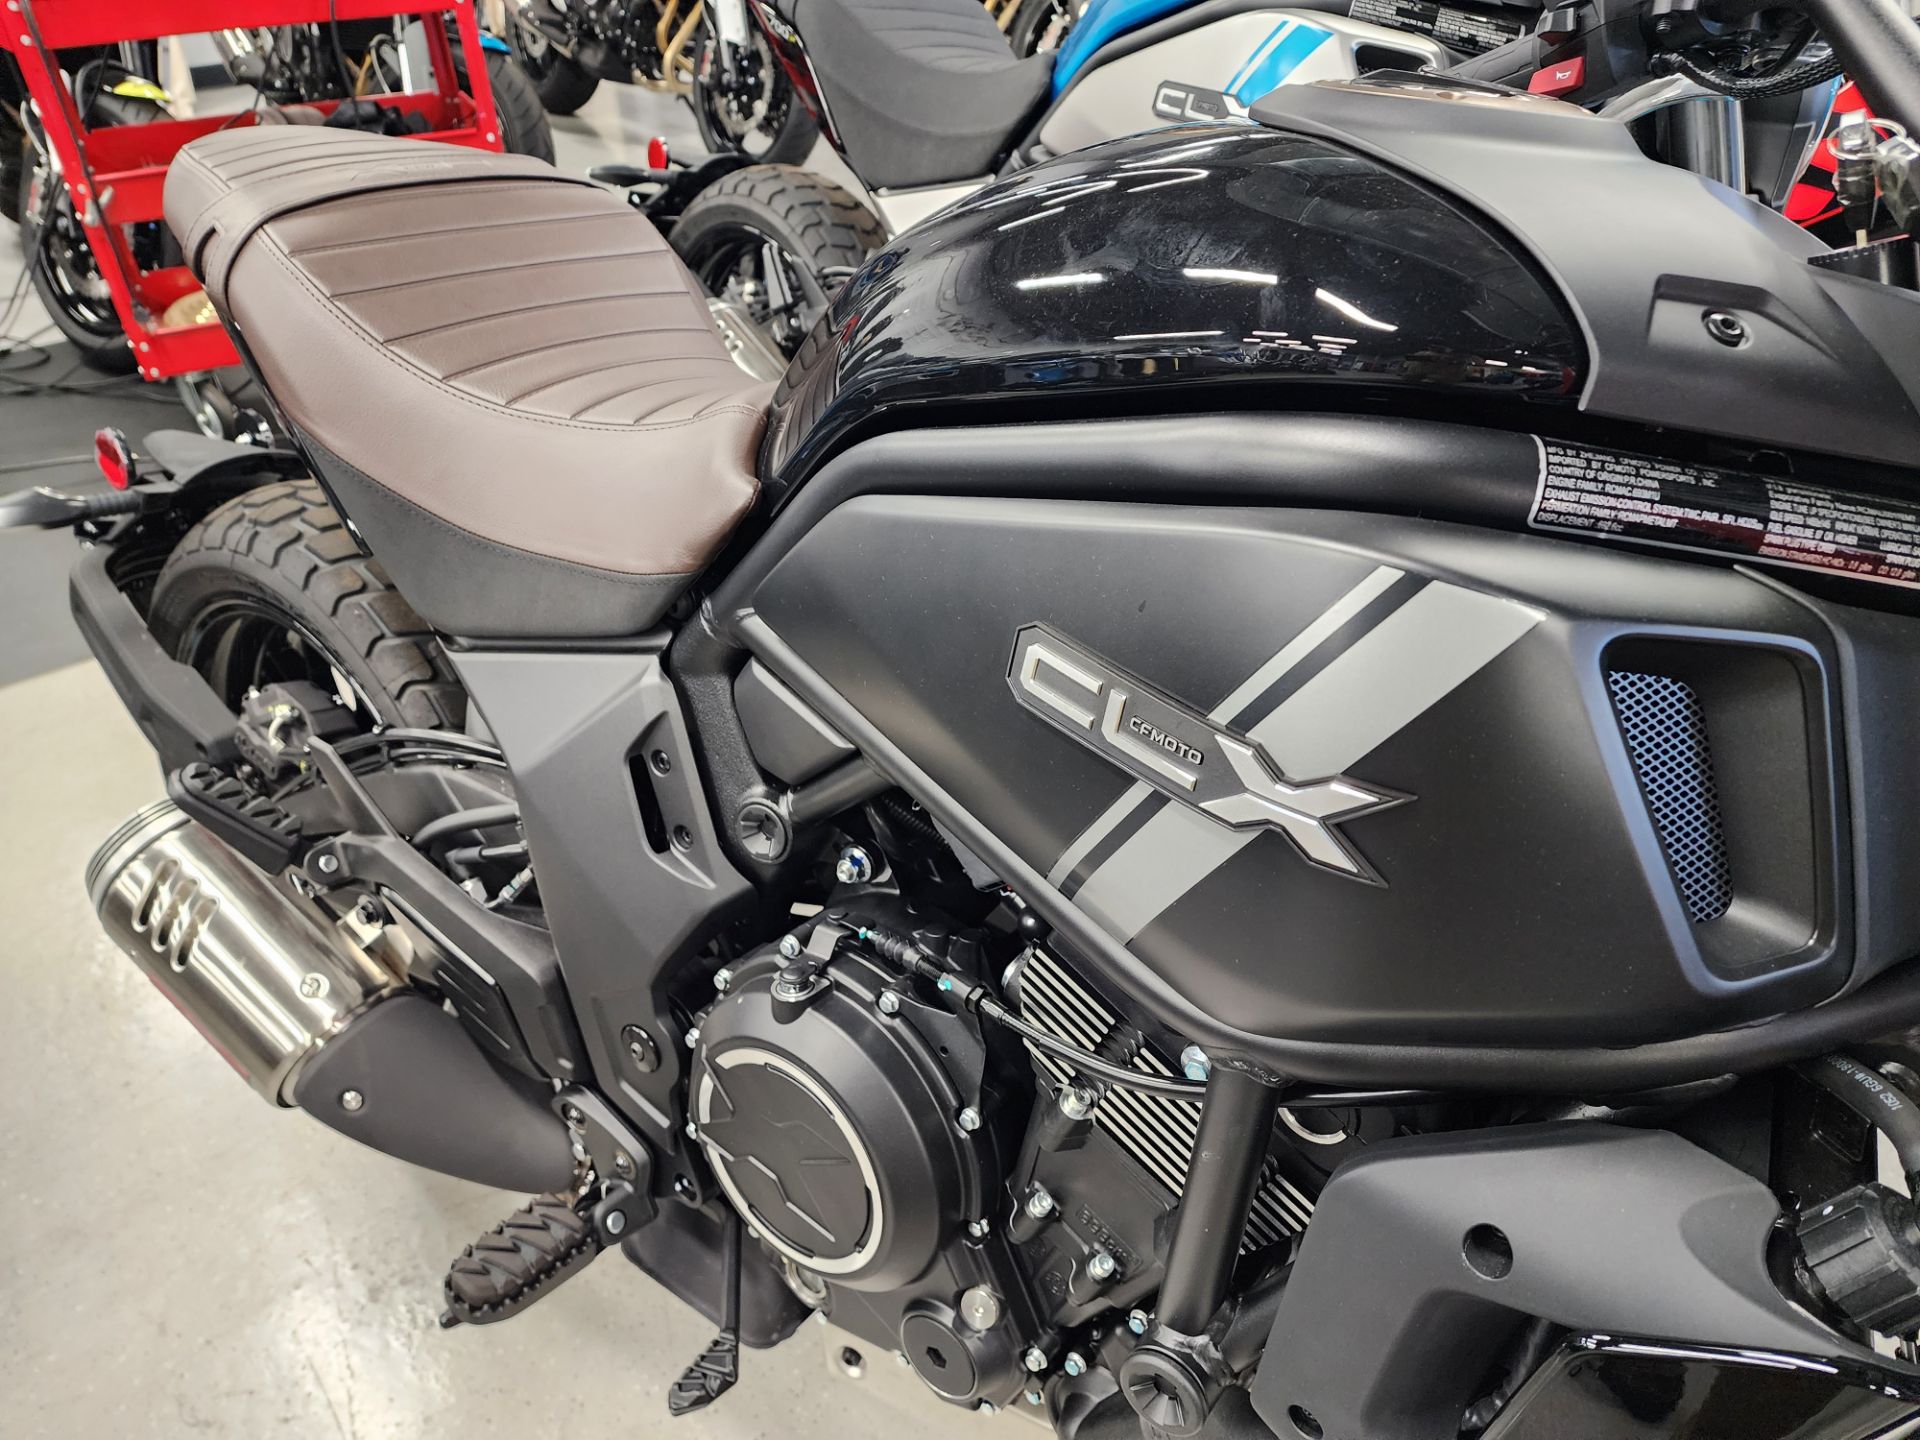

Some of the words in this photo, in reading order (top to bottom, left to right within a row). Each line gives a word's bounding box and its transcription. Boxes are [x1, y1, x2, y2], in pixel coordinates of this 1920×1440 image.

[1547, 454, 1587, 468] IMPORTED
[1548, 464, 1585, 478] COUNTRY
[1585, 469, 1597, 479] OF
[1129, 715, 1205, 767] CFMOTO
